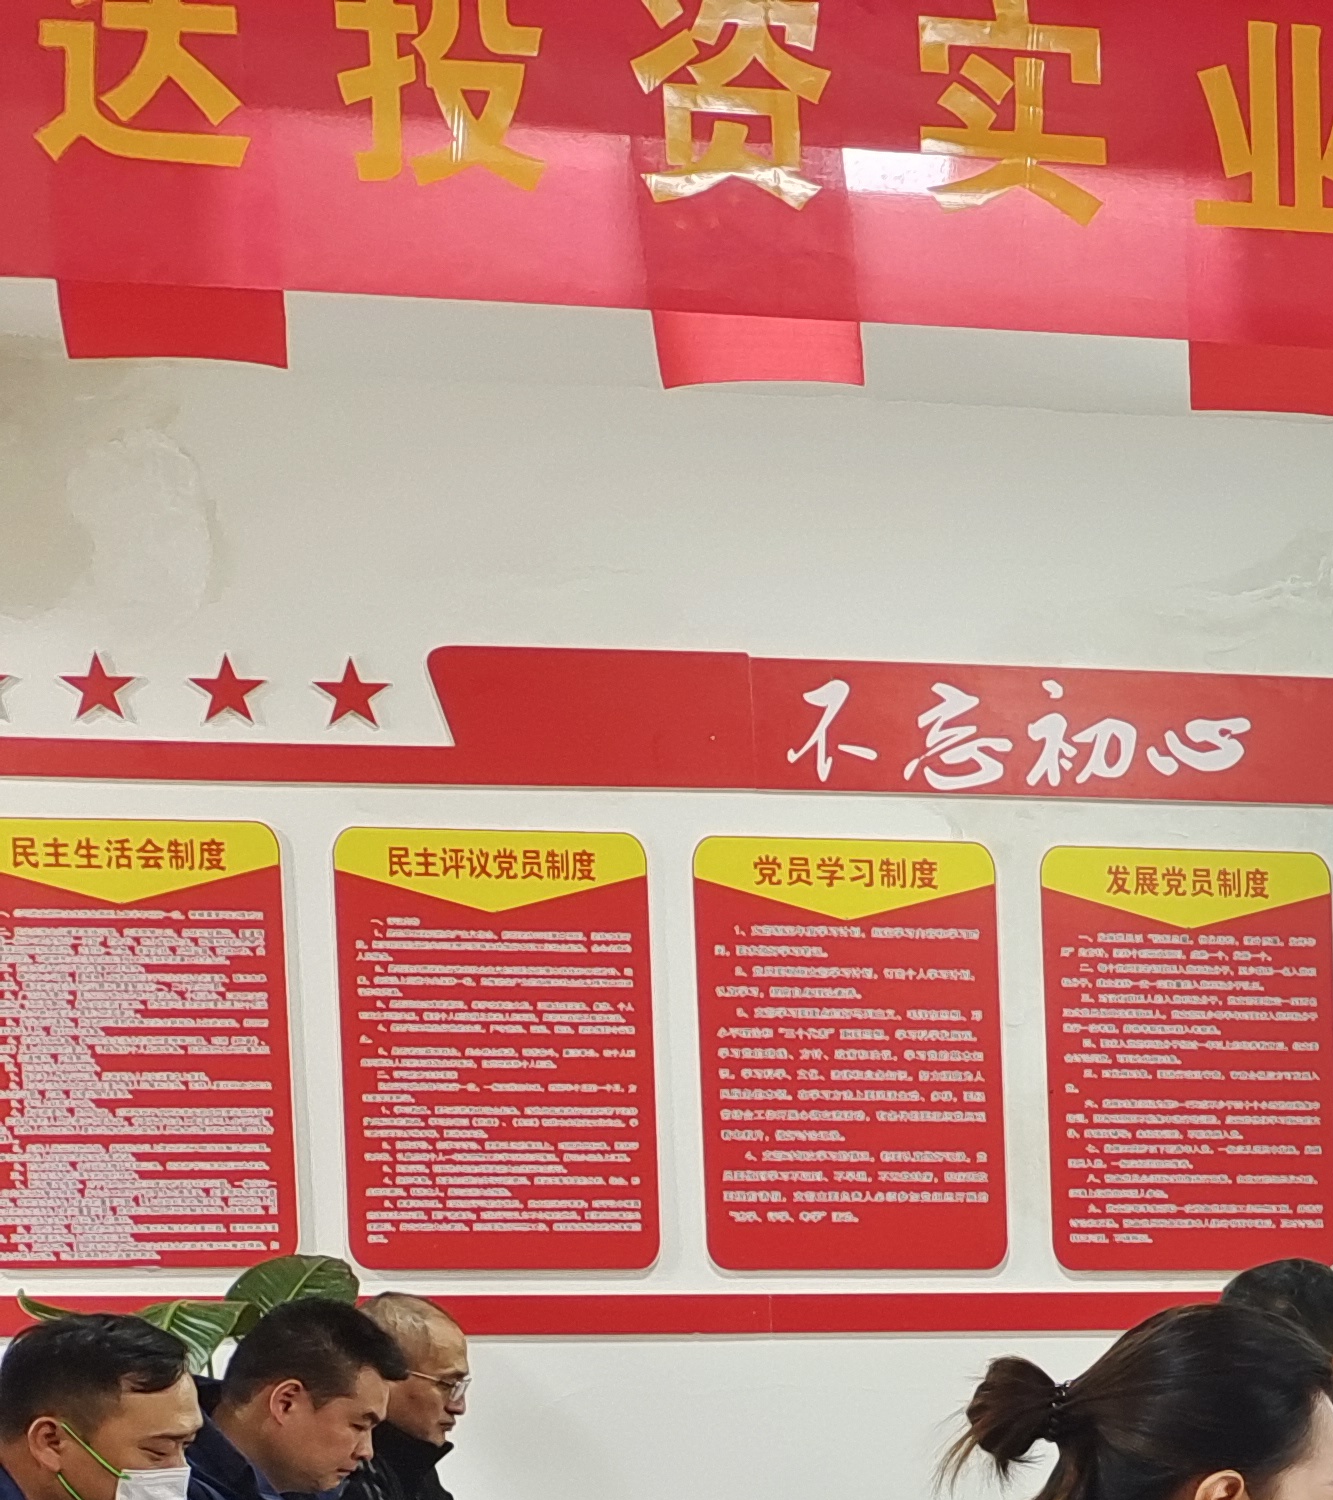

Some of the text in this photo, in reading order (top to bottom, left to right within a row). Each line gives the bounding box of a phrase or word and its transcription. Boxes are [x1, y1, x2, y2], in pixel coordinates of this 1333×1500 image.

[786, 677, 1251, 788] 不忘初心
[11, 836, 227, 871] 民主生活会制度
[387, 846, 597, 882] 民主评议党员制度
[753, 853, 939, 890] 党员学习制度
[1106, 865, 1270, 899] 发展党员制度
